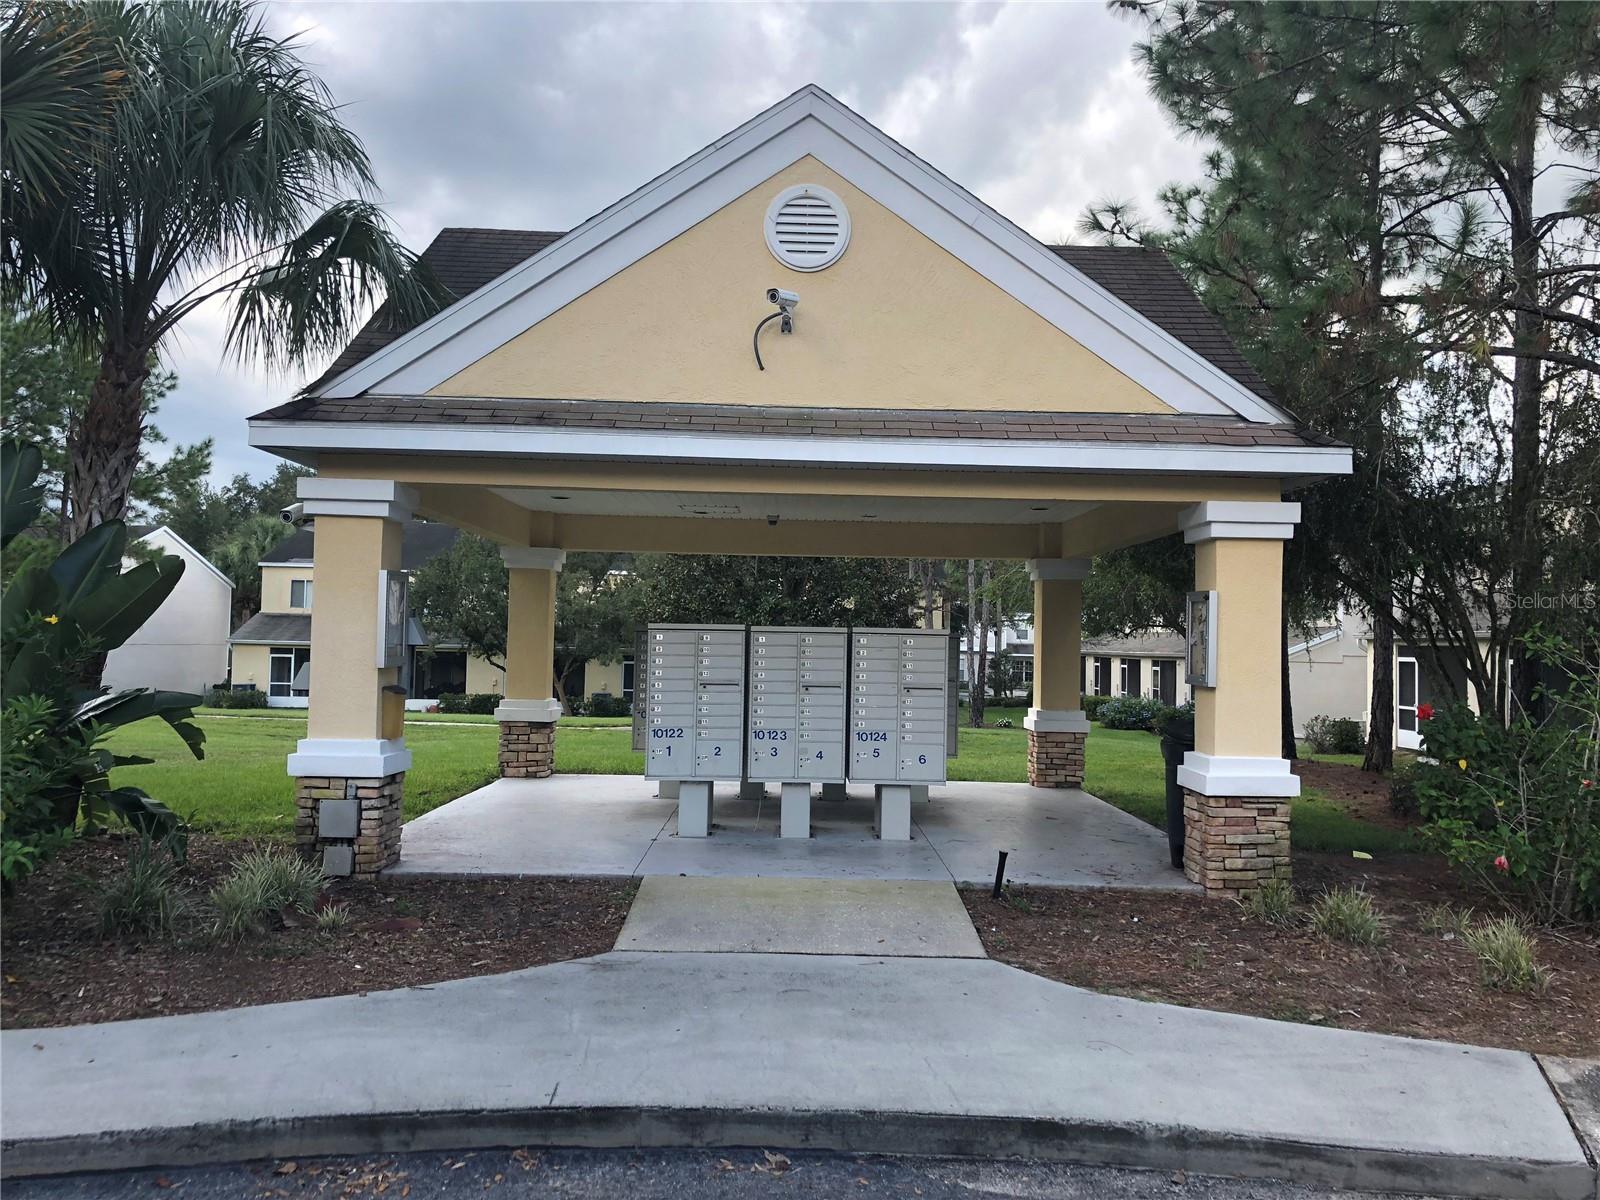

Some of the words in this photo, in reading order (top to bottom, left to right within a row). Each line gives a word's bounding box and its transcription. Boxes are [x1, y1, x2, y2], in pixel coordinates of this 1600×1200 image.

[652, 728, 684, 738] 10122
[856, 732, 887, 742] 10124
[666, 746, 671, 756] 1
[714, 746, 721, 756] 2
[770, 747, 778, 756] 3
[816, 751, 823, 760] 4
[872, 748, 880, 758] 5
[918, 755, 926, 764] 6
